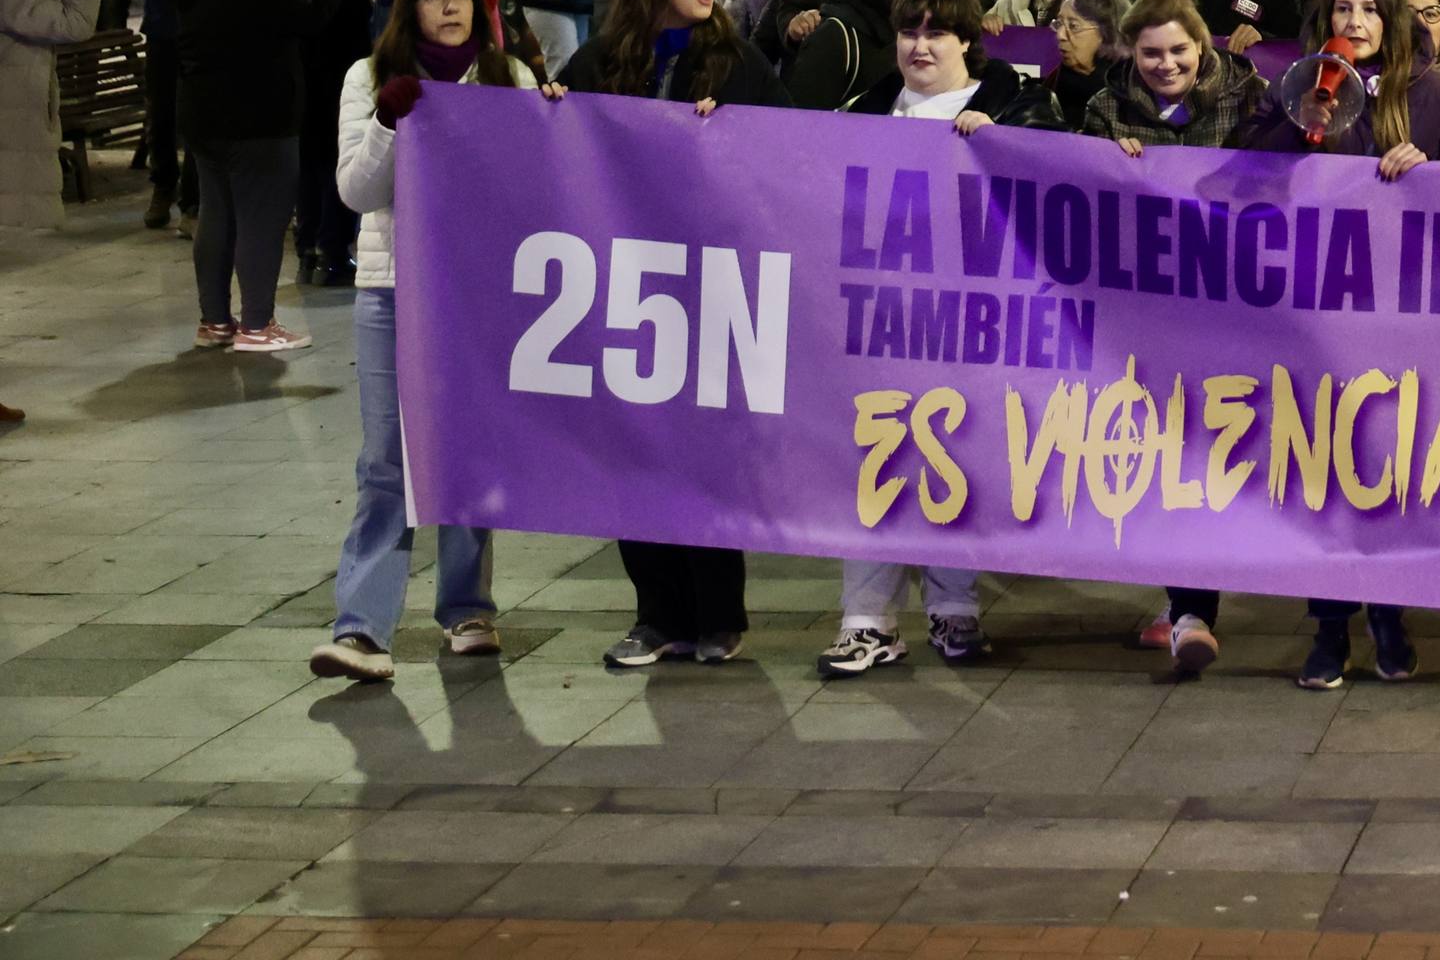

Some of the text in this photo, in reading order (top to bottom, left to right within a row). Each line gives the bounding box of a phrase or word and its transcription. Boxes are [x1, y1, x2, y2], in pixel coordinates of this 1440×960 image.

[840, 166, 933, 274] LA
[954, 173, 1375, 312] VIOLENCIA
[509, 230, 790, 414] 25N
[841, 283, 1095, 371] TAMBIÉN
[854, 387, 969, 527] ES
